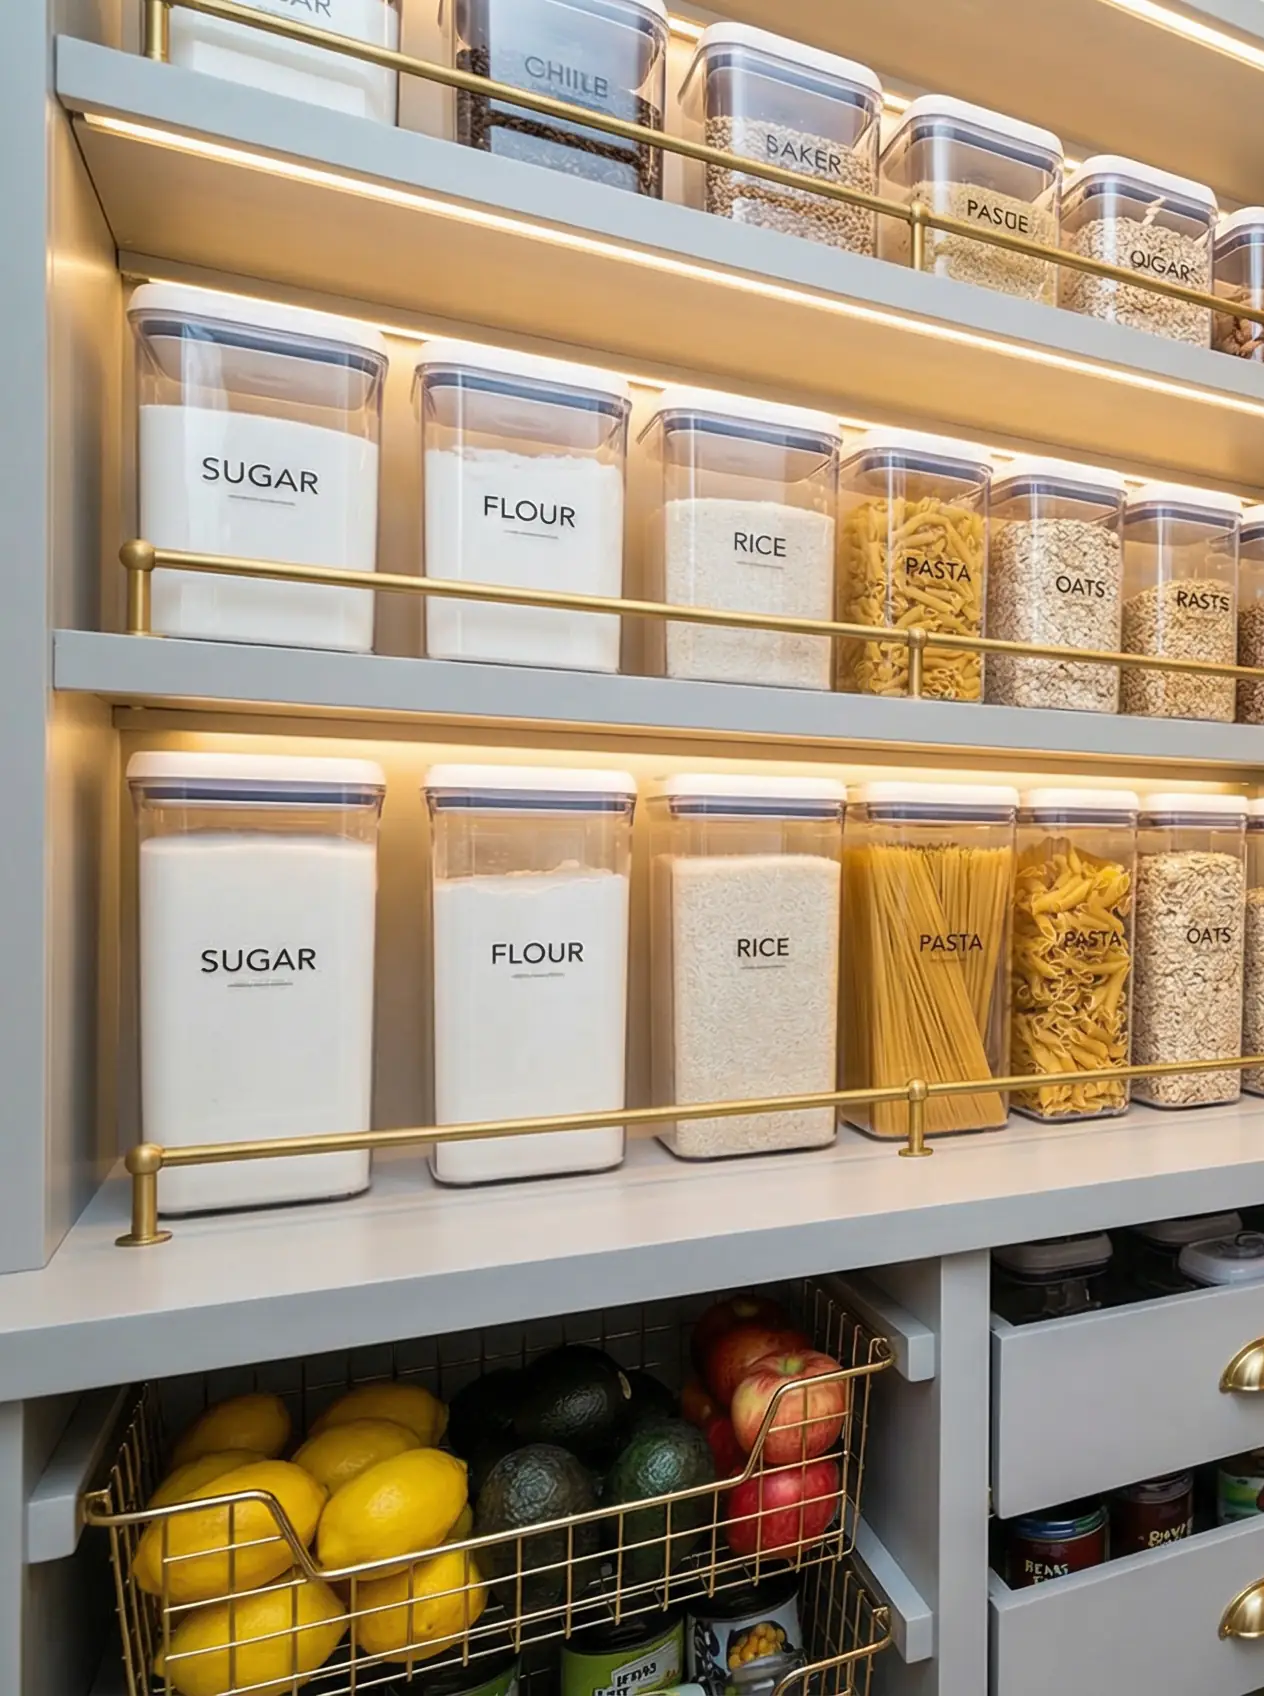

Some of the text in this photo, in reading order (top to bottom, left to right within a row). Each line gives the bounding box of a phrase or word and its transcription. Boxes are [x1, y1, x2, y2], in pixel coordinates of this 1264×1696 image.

[202, 457, 319, 495] SUGAR
[484, 496, 576, 529] FLOUR
[734, 532, 786, 558] RICE
[906, 557, 971, 583] PASTA
[1056, 576, 1106, 598] OATS
[737, 937, 789, 958] RICE
[919, 933, 983, 953] PASTA
[1064, 930, 1122, 948] PASTA
[1187, 926, 1232, 945] OATS
[200, 948, 317, 974] SUGAR
[491, 941, 585, 965] FLOUR
